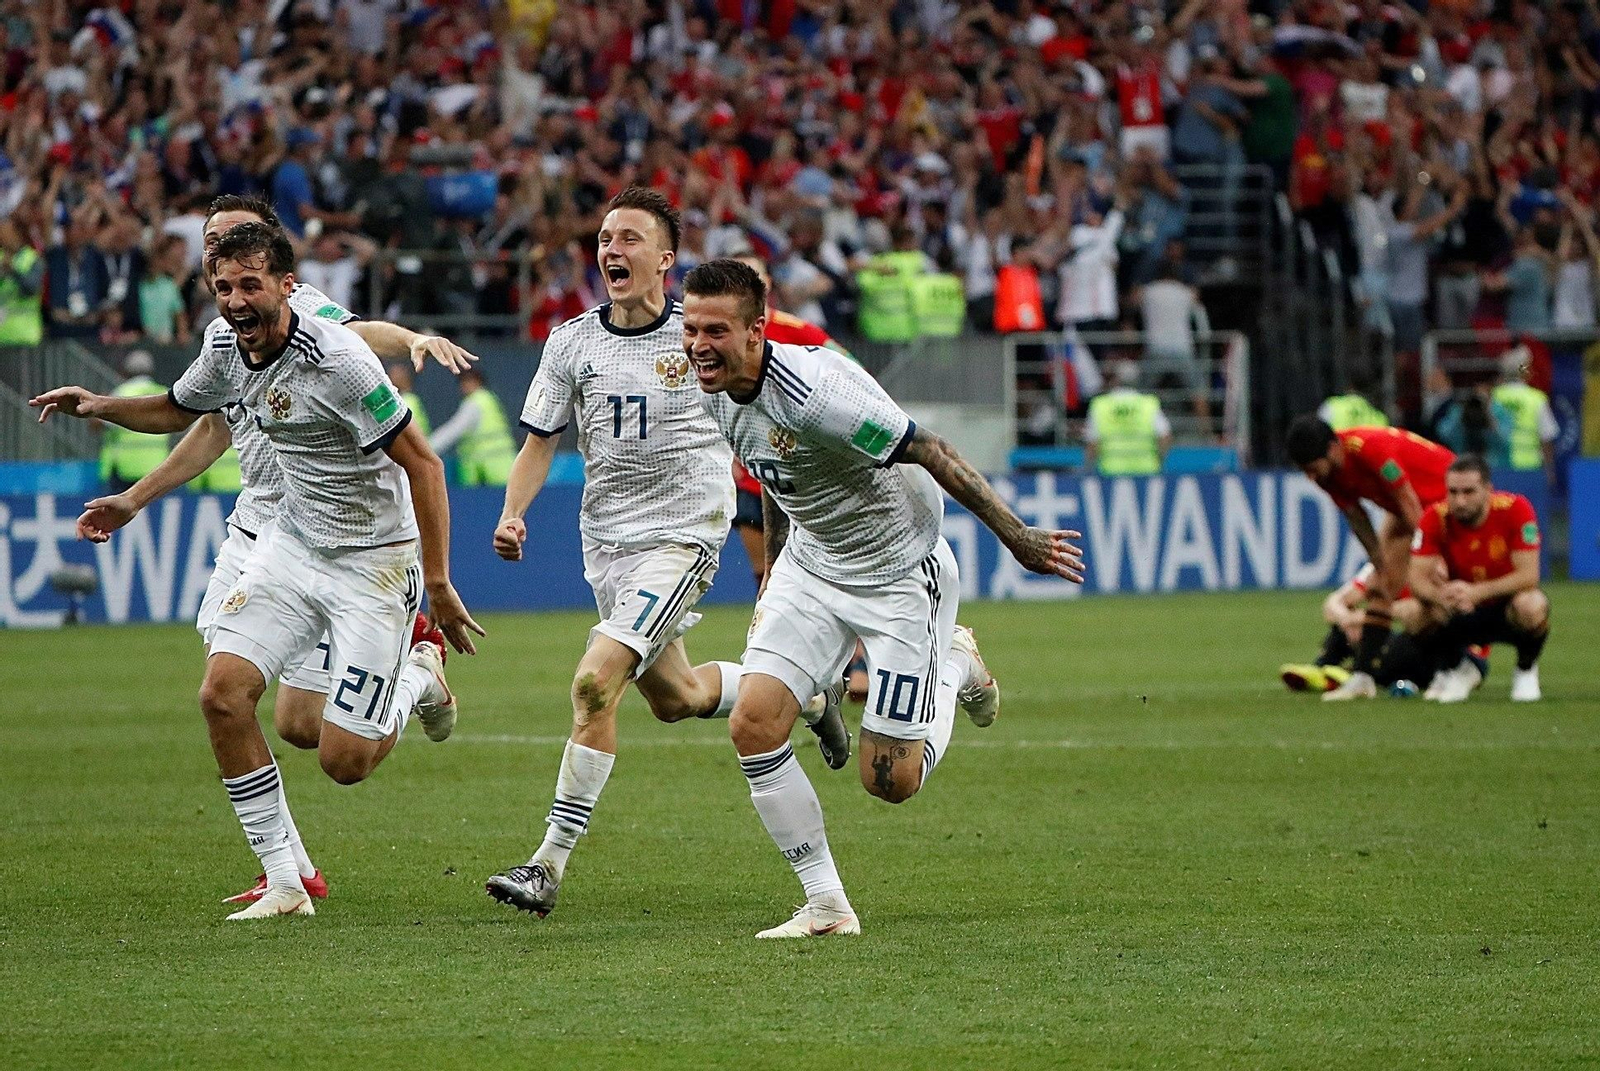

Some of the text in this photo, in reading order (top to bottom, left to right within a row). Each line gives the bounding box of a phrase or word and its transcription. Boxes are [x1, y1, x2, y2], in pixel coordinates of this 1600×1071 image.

[631, 588, 660, 632] 7
[333, 665, 385, 720] 21
[875, 667, 920, 722] 10
